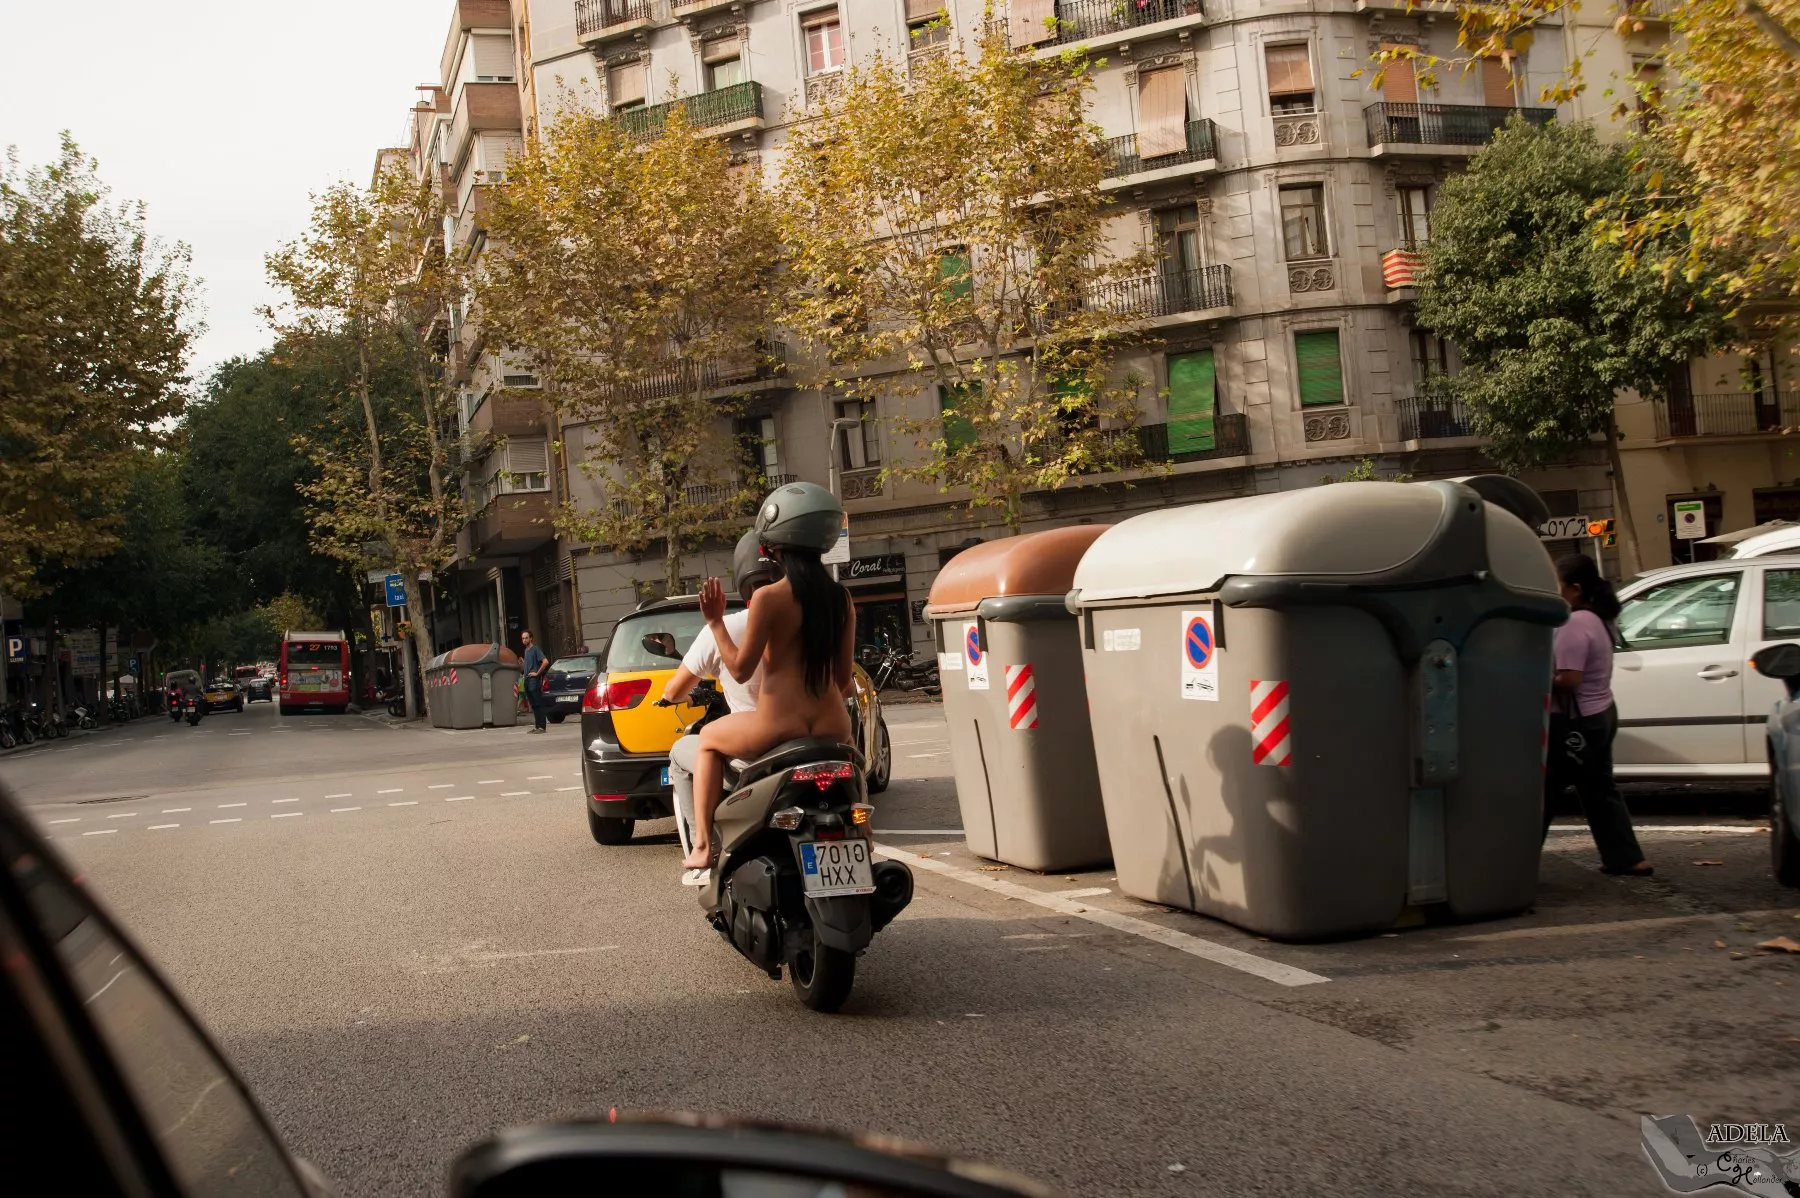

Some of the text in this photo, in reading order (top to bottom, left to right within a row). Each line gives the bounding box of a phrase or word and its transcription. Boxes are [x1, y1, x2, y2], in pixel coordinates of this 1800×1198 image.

[850, 558, 882, 577] Coral
[9, 639, 23, 657] P
[309, 644, 320, 652] 27
[816, 843, 865, 865] 7010
[820, 865, 857, 886] HXX
